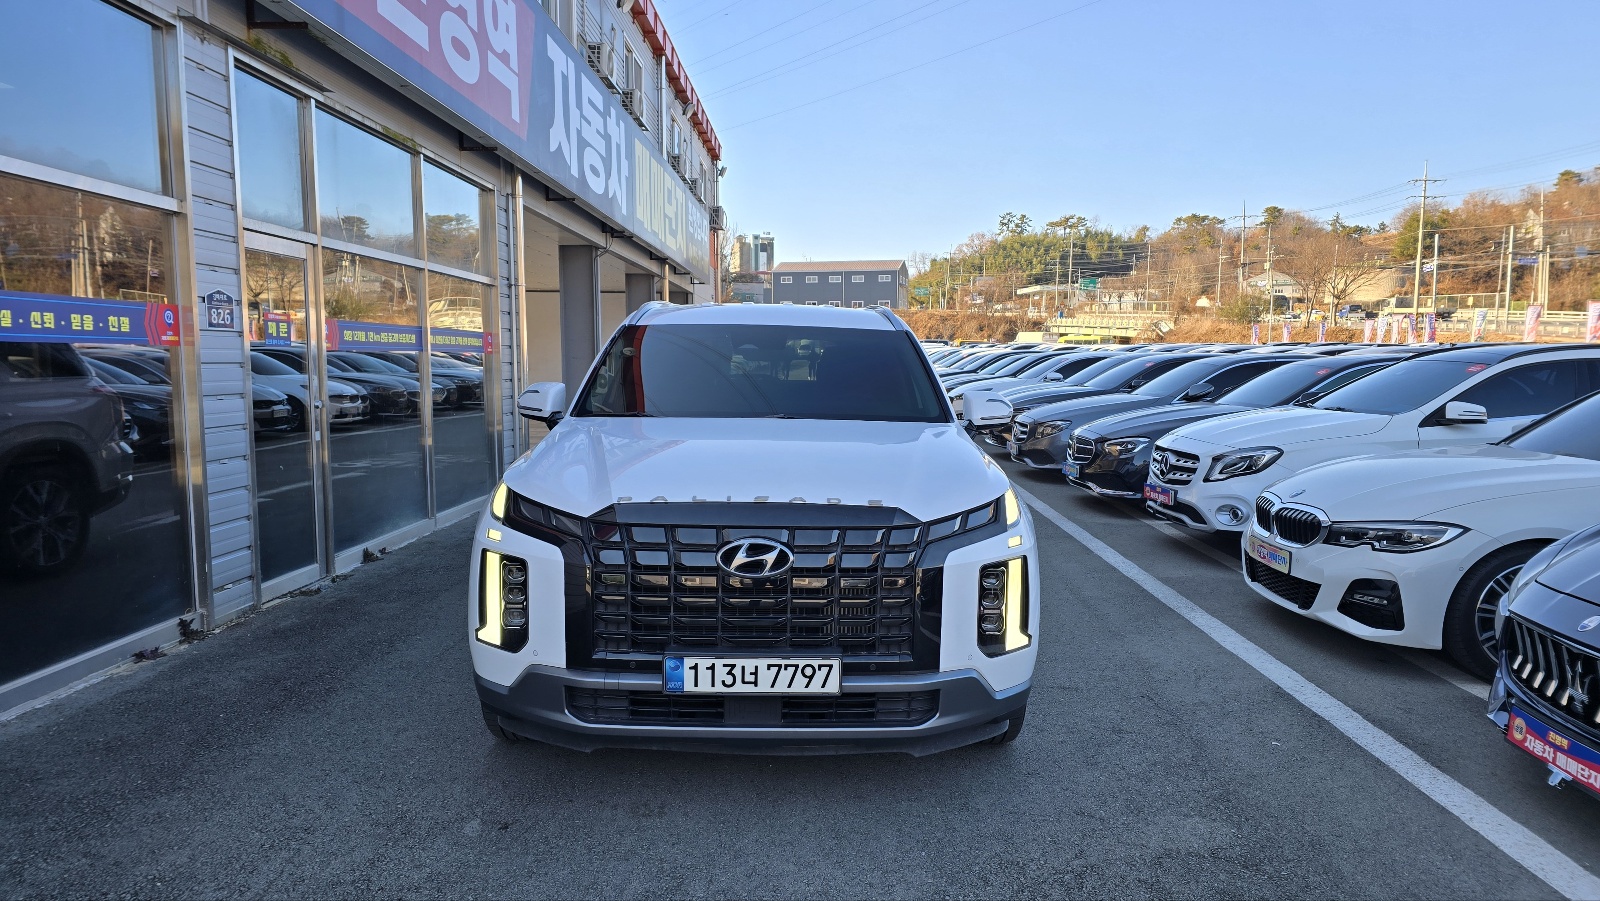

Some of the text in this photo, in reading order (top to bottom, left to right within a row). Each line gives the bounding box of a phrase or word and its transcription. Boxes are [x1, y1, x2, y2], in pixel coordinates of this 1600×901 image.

[547, 34, 629, 216] 자동차
[635, 137, 687, 259] 매매단지
[30, 311, 55, 329] 신뢰
[70, 313, 94, 331] 믿음
[107, 315, 130, 332] 친절
[211, 308, 231, 324] 826
[688, 662, 835, 689] 113너 7797
[1524, 733, 1600, 790] 자동차 매매단지
